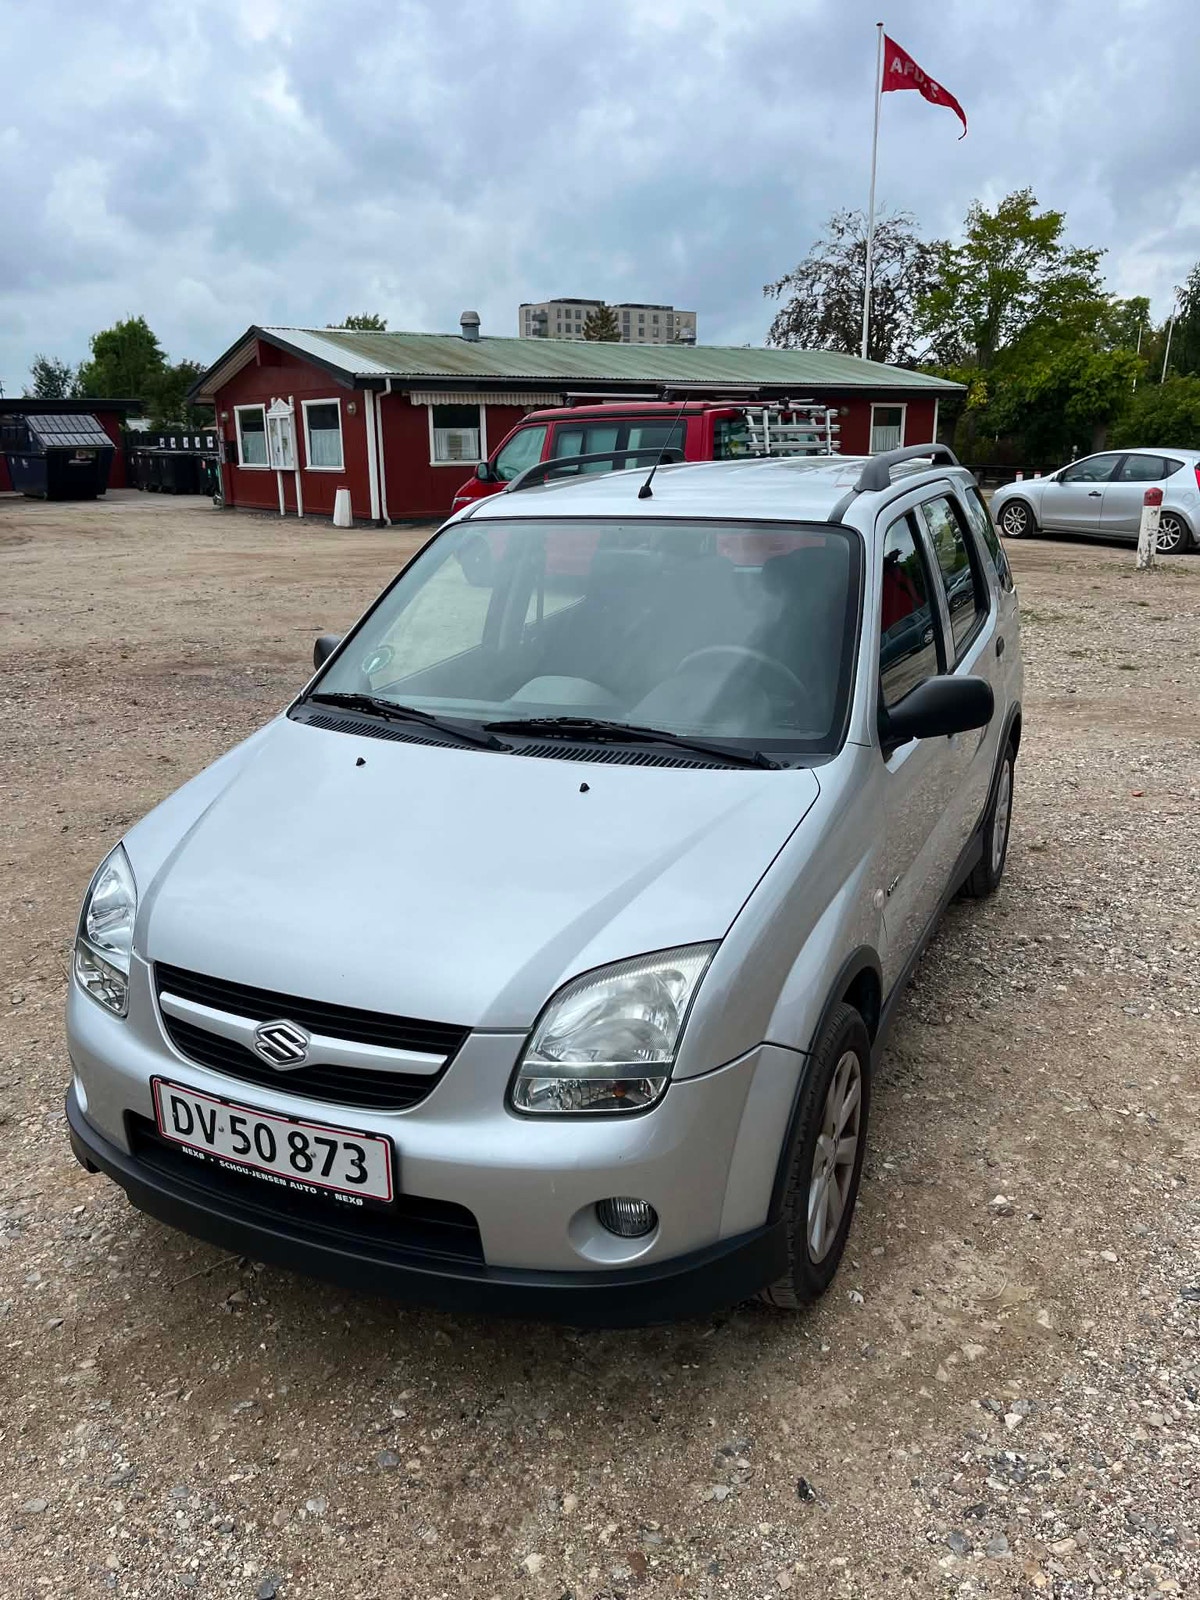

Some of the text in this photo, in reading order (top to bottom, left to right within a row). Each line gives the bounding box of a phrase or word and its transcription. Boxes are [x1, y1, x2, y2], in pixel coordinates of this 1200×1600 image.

[170, 1094, 368, 1184] DV 50 873
[219, 1160, 287, 1186] SCHOU-JENSEN
[289, 1181, 318, 1194] AUTO
